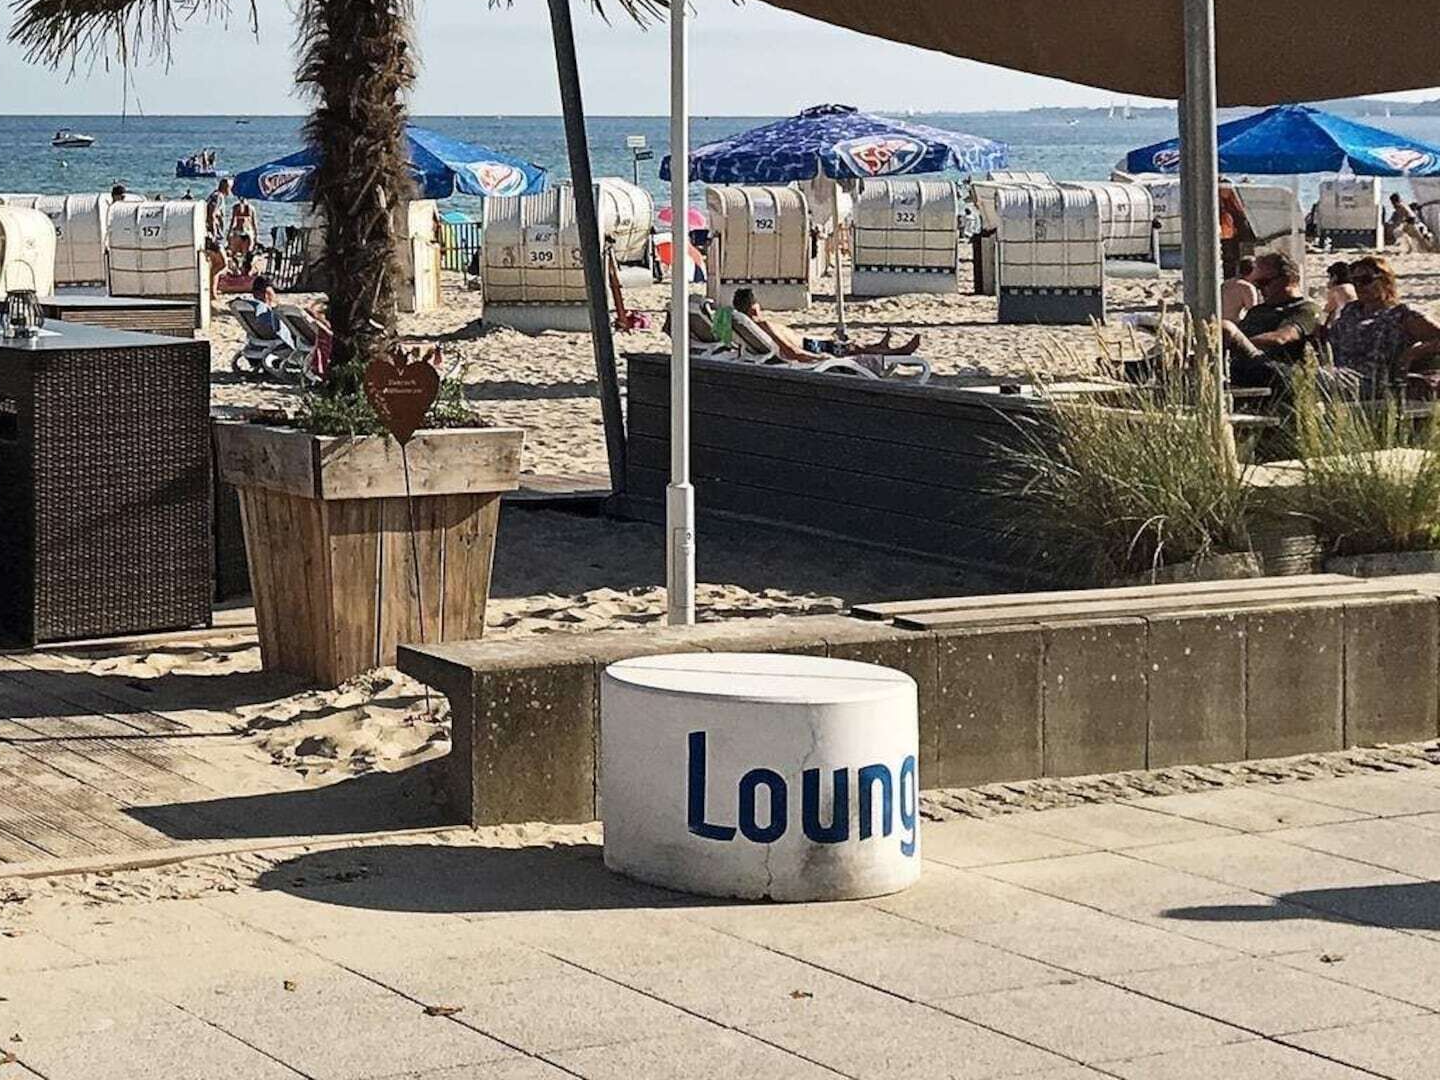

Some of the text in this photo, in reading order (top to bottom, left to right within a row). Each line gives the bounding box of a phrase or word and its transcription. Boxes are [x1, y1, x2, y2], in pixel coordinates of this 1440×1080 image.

[895, 212, 916, 223] 322
[755, 219, 774, 230] 192
[141, 226, 161, 237] 157
[529, 251, 554, 262] 309
